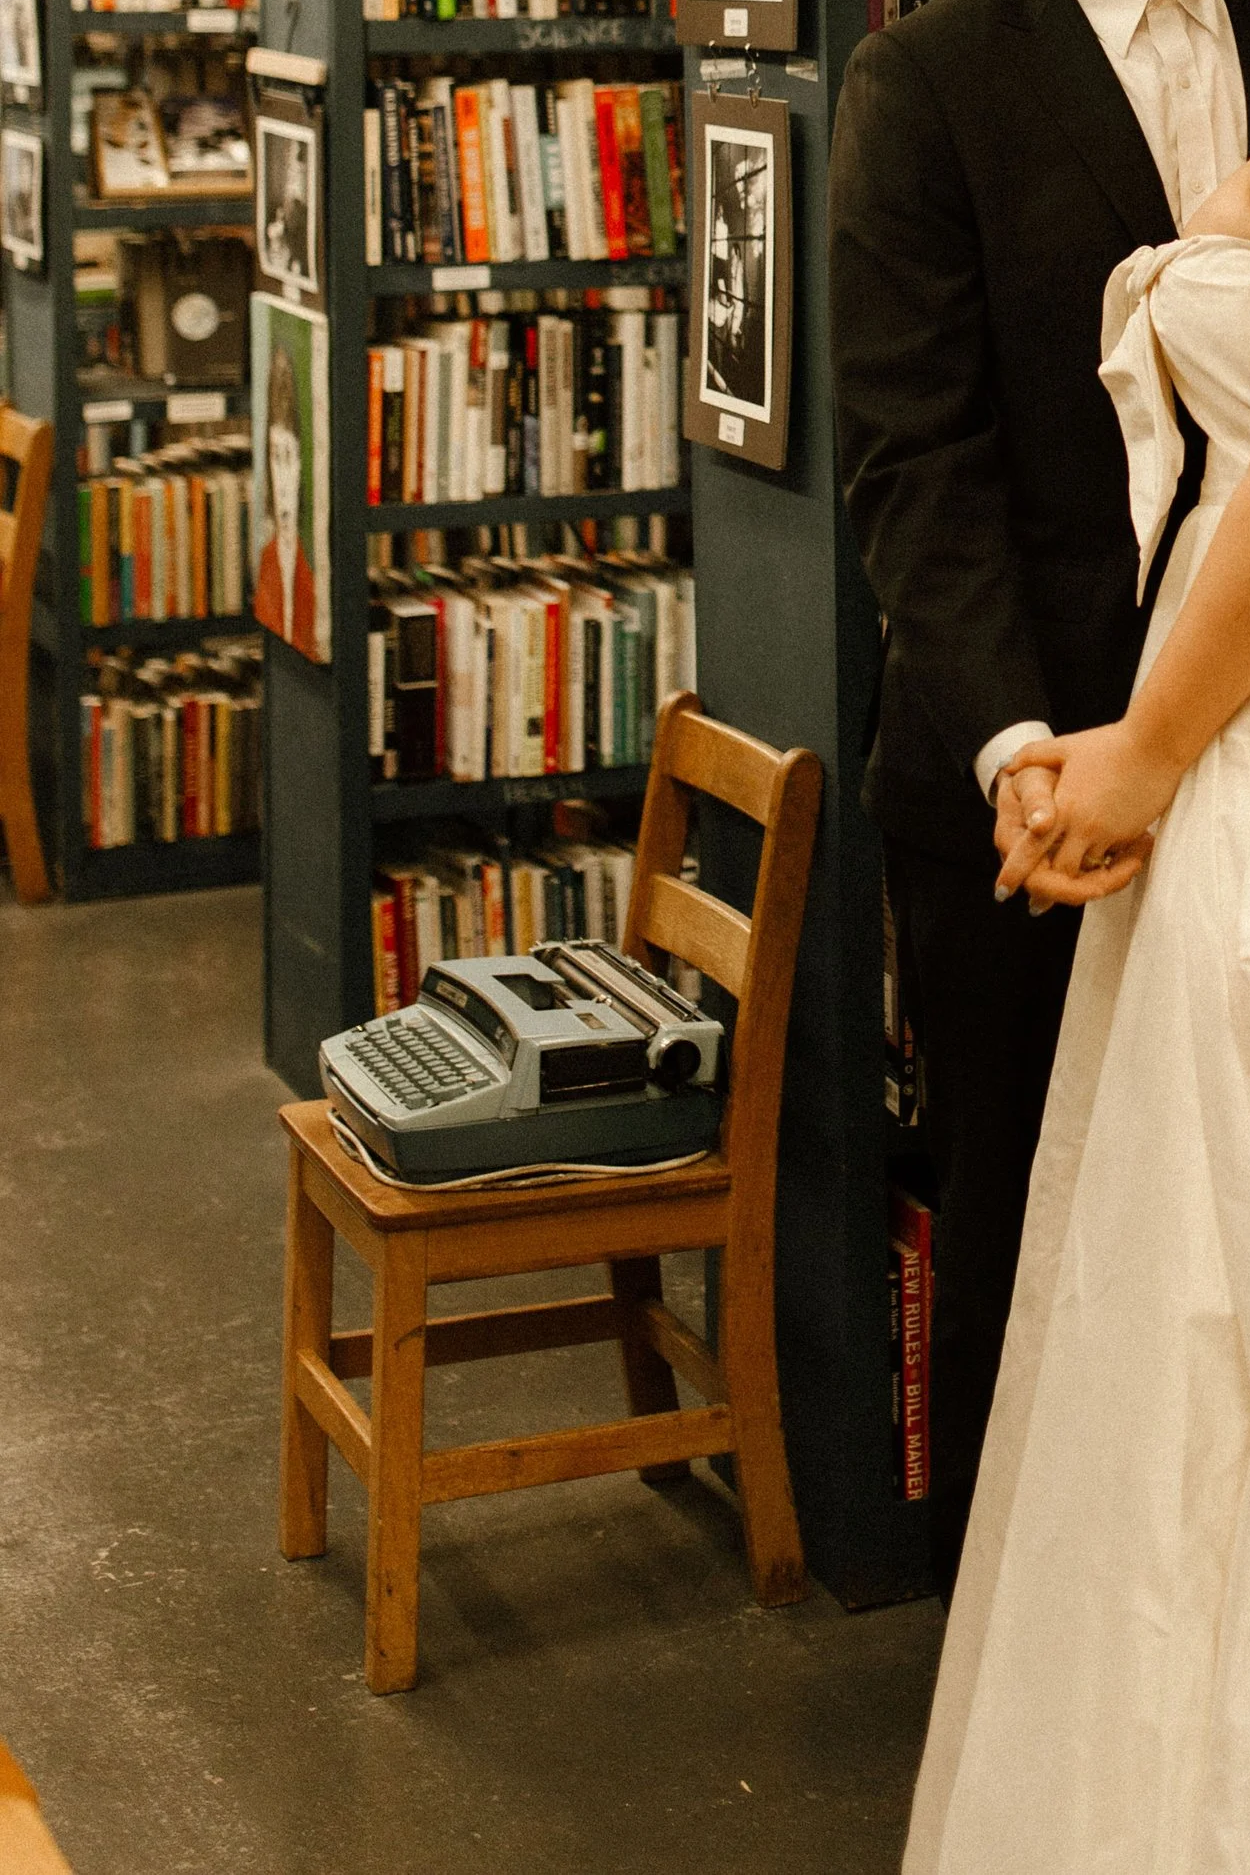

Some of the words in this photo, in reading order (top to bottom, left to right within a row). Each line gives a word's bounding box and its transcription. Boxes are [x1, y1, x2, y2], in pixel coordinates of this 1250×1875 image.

[903, 1252, 920, 1295] NEW
[904, 1302, 921, 1365] RULES
[891, 1371, 901, 1425] Monologue
[906, 1384, 922, 1428] BILL
[906, 1433, 924, 1501] MAHER
